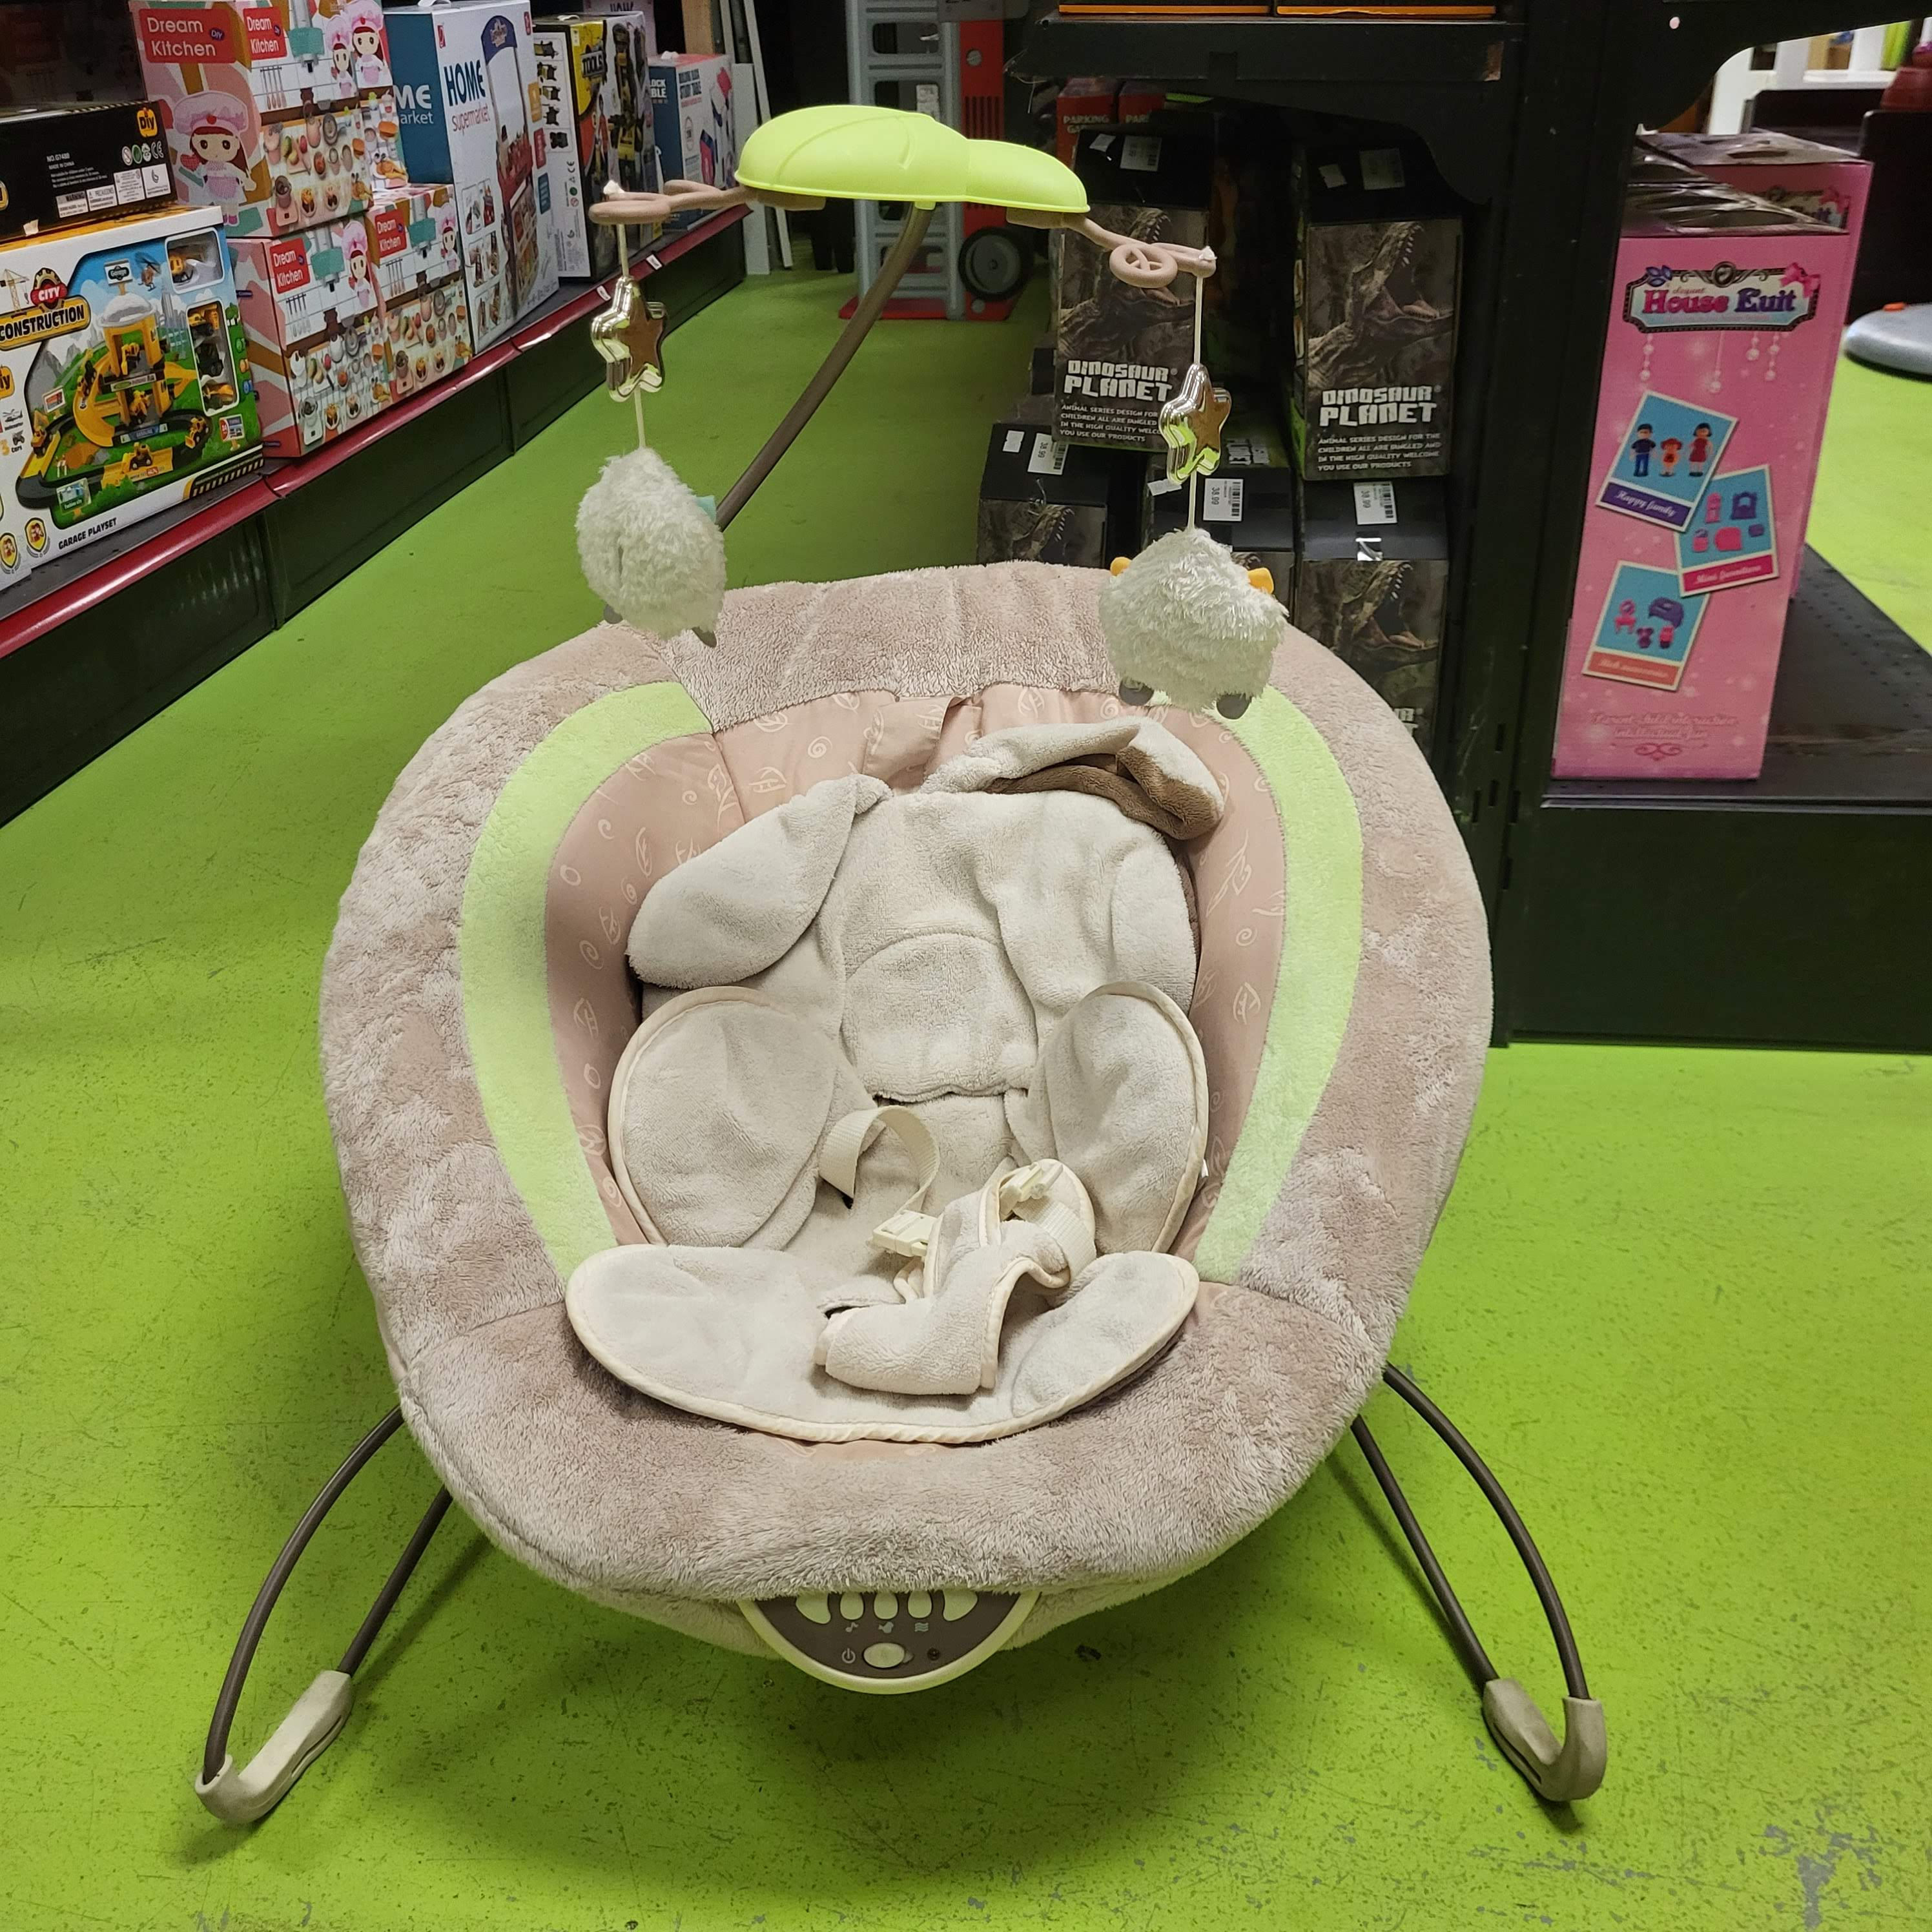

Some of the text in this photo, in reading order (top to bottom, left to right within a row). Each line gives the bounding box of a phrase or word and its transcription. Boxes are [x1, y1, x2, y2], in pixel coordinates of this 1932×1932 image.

[147, 17, 203, 33] Dream
[247, 16, 272, 32] Dream
[151, 40, 216, 56] Kitchen
[250, 39, 279, 54] Kitchen
[582, 51, 604, 75] TOOLS
[444, 59, 486, 107] HOME
[393, 85, 432, 110] ME
[650, 88, 667, 98] BLE
[400, 111, 434, 125] arket
[452, 103, 490, 136] supermarket
[1064, 114, 1109, 124] PARKING
[377, 219, 396, 234] Dream
[380, 235, 401, 252] Kitchen
[272, 251, 297, 267] Dream
[276, 269, 303, 287] Kitchen
[38, 287, 60, 301] CITY
[1642, 289, 1729, 314] House
[1068, 360, 1169, 382] DINOSAUR
[1064, 375, 1173, 402] PLANET
[1322, 386, 1432, 405] DINOSAUR
[1319, 402, 1437, 426] PLANET
[1105, 425, 1136, 433] QUALITY
[1108, 433, 1146, 442] PRODUCTS
[59, 517, 117, 550] GARAGE PLAYSET
